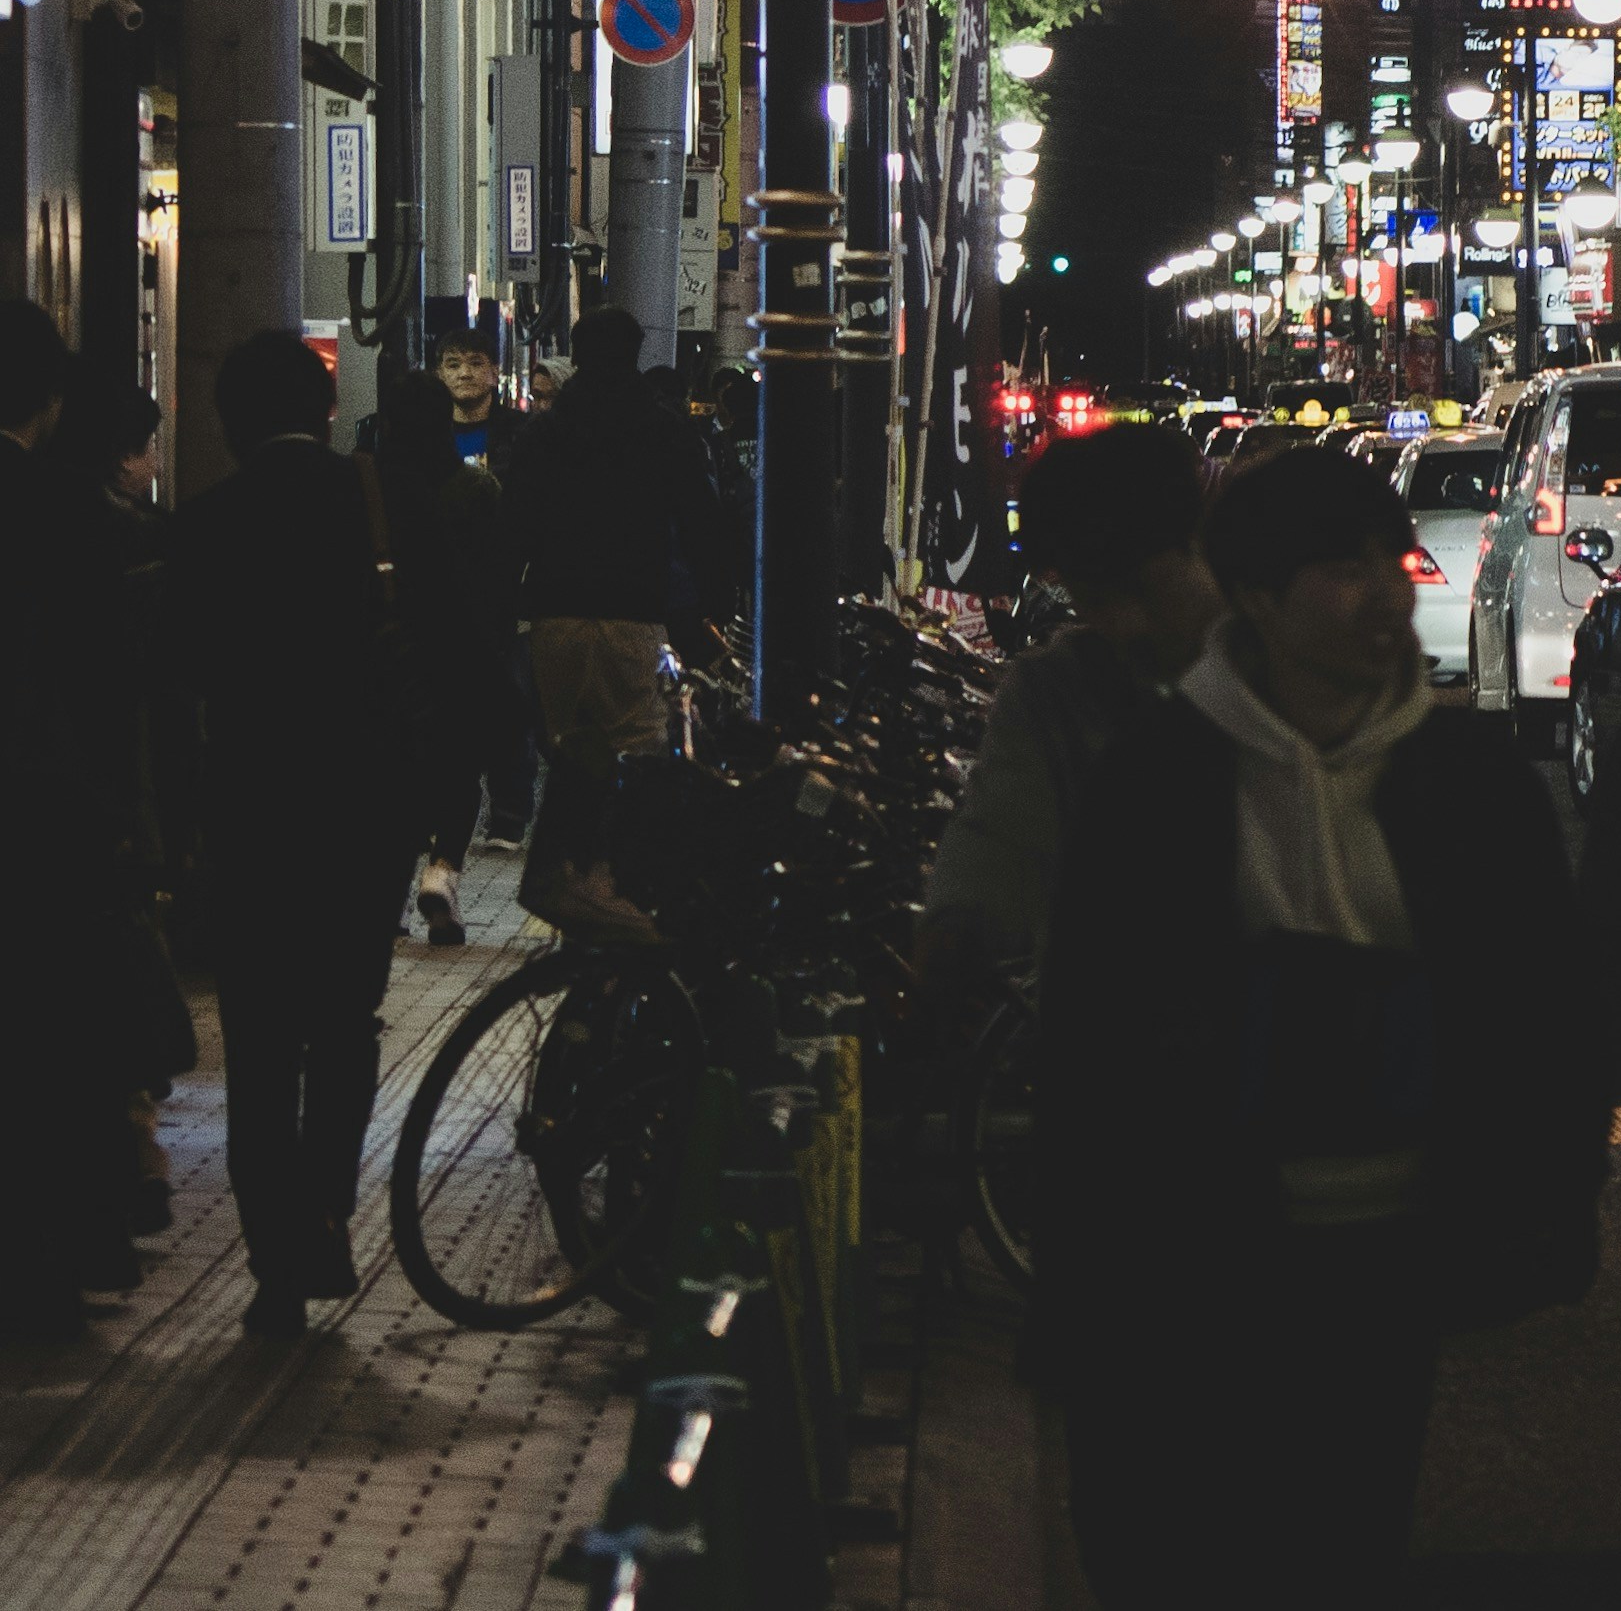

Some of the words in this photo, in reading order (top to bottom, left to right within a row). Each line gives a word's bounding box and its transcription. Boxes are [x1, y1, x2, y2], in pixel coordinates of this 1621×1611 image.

[335, 132, 355, 235] 防犯カメラ設置
[512, 170, 529, 250] 防犯カメラ設置
